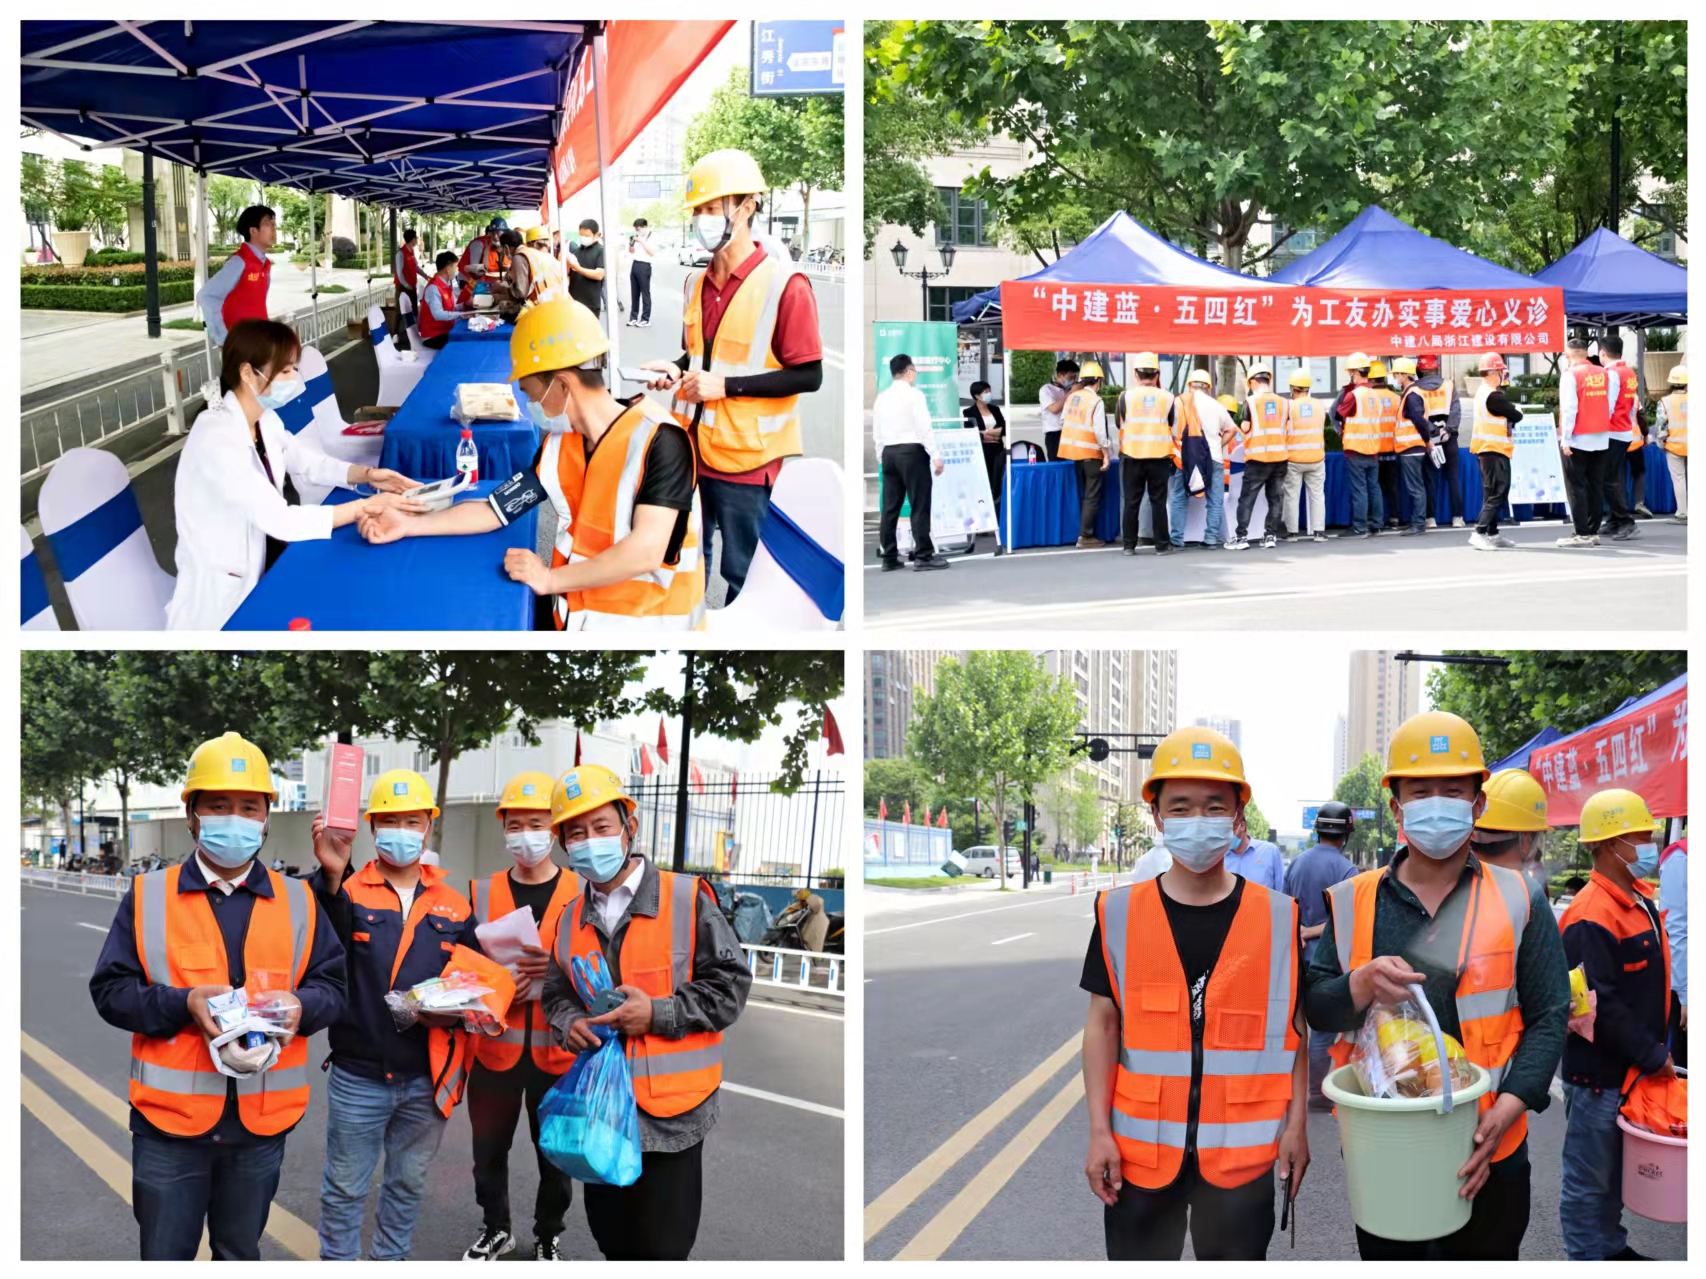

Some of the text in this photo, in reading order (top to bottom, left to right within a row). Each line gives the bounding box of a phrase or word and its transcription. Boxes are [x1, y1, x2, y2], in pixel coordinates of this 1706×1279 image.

[760, 28, 776, 85] 江秀街
[1291, 295, 1549, 328] 为工友办实事爱心义诊
[1390, 332, 1549, 348] 中建八局浙江建设有限公司
